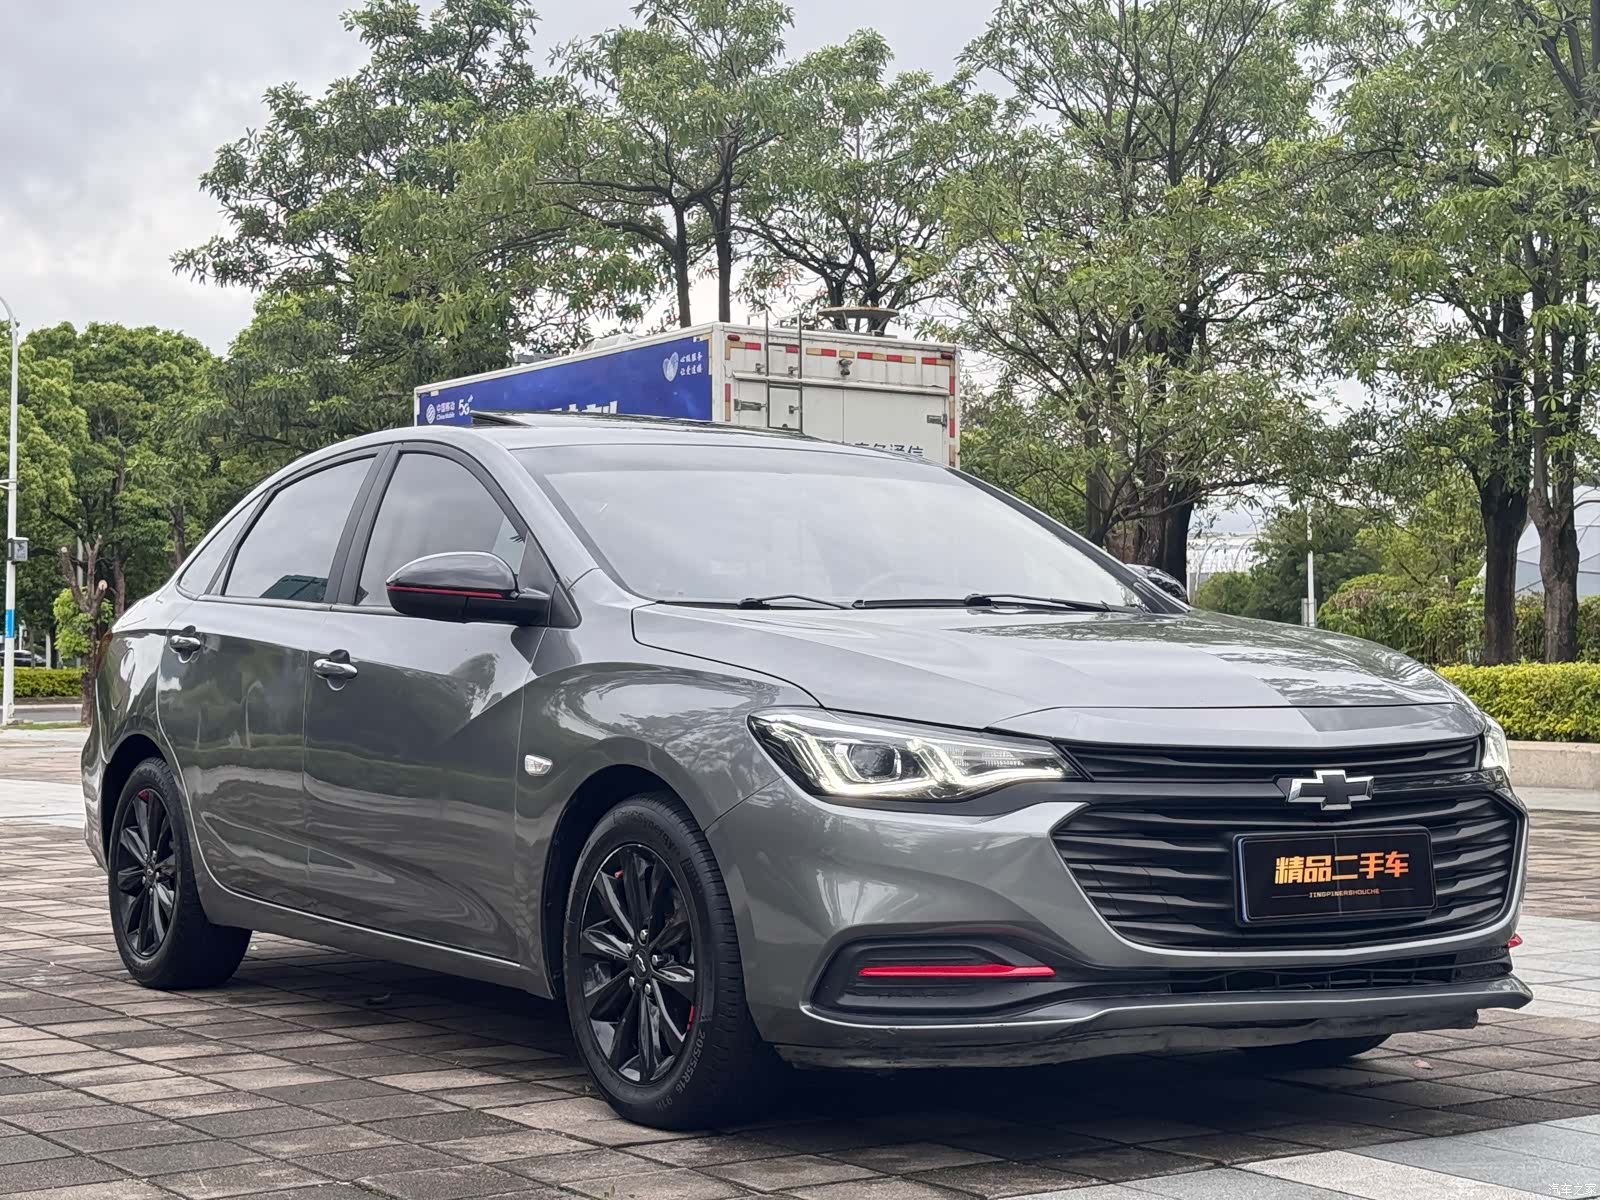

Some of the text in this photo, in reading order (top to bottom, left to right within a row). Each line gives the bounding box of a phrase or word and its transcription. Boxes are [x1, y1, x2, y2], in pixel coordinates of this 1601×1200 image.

[1274, 851, 1410, 884] 精品二手车
[675, 1028, 706, 1094] 205/55R16
